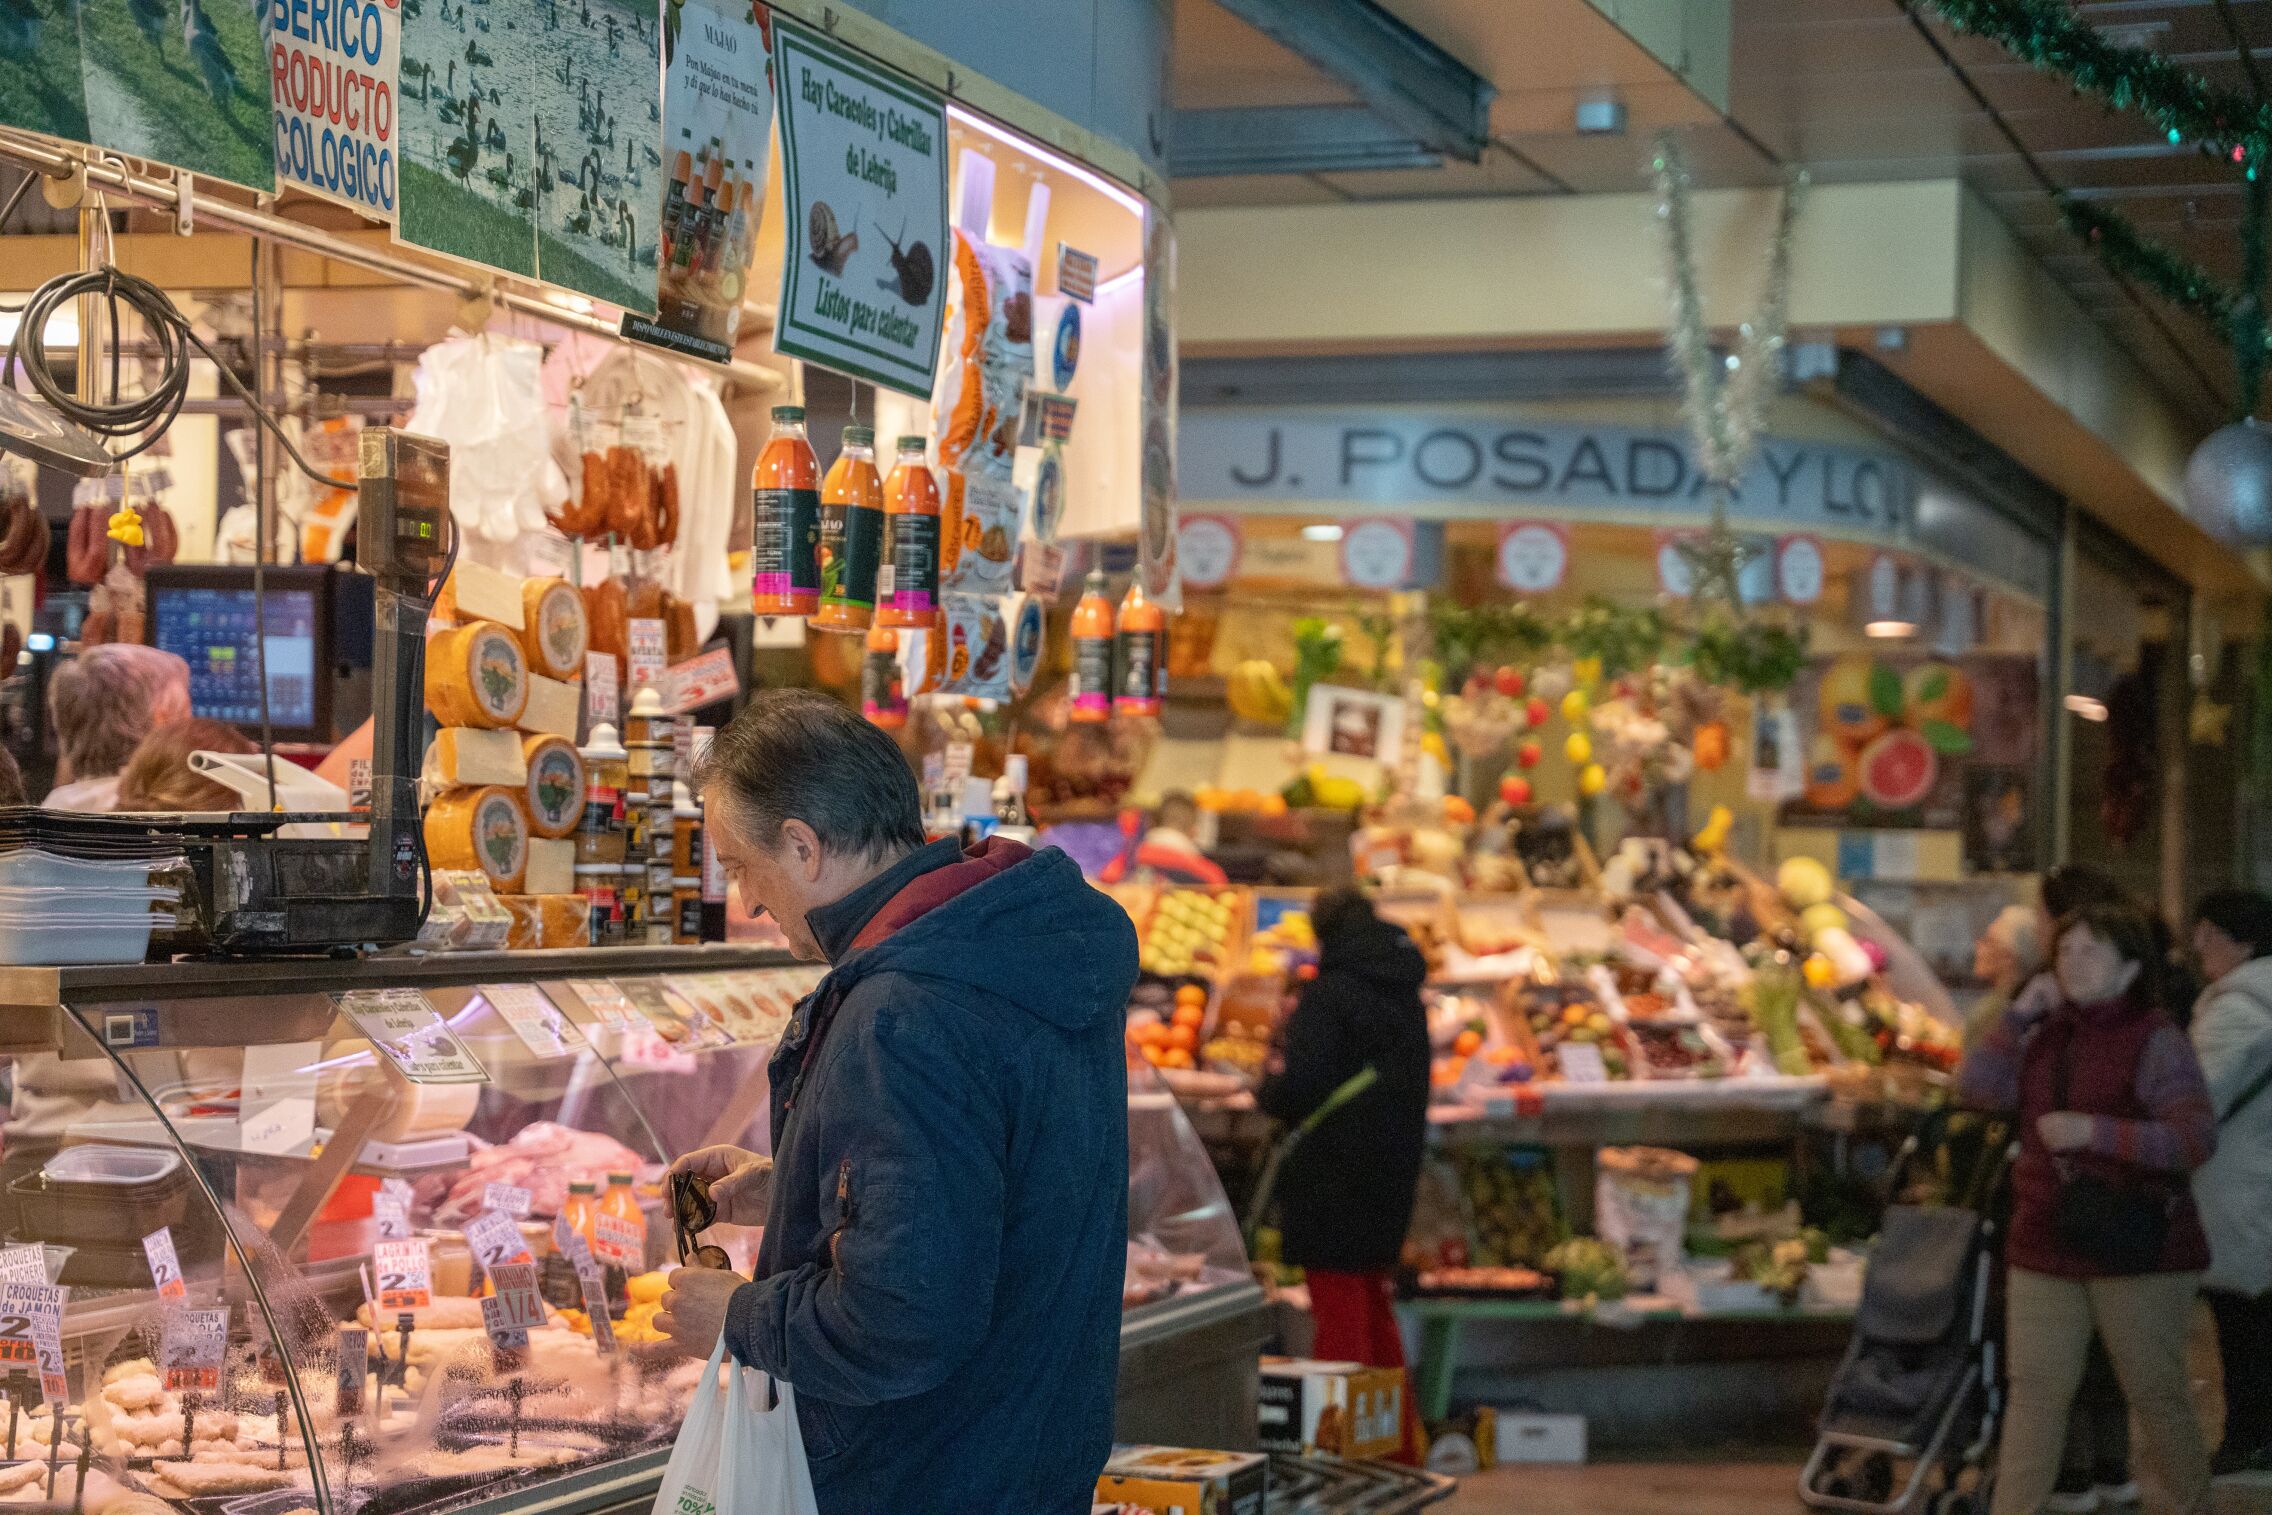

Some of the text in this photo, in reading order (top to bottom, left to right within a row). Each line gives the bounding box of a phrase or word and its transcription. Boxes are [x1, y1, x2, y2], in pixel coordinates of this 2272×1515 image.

[704, 24, 737, 54] MAJAO
[802, 66, 824, 114] Hay
[826, 79, 877, 132] Caracoles
[878, 111, 886, 142] y
[846, 143, 859, 177] de
[814, 276, 851, 325] Listos
[1228, 428, 1298, 488] J.
[1763, 447, 1807, 504] Y
[9, 1263, 44, 1283] PUCHERO
[155, 1264, 170, 1285] 2
[381, 1272, 407, 1291] 2
[2, 1300, 15, 1313] de
[7, 1285, 60, 1303] CROQUETAS
[504, 1290, 541, 1324] 1/4
[39, 1349, 53, 1372] 2
